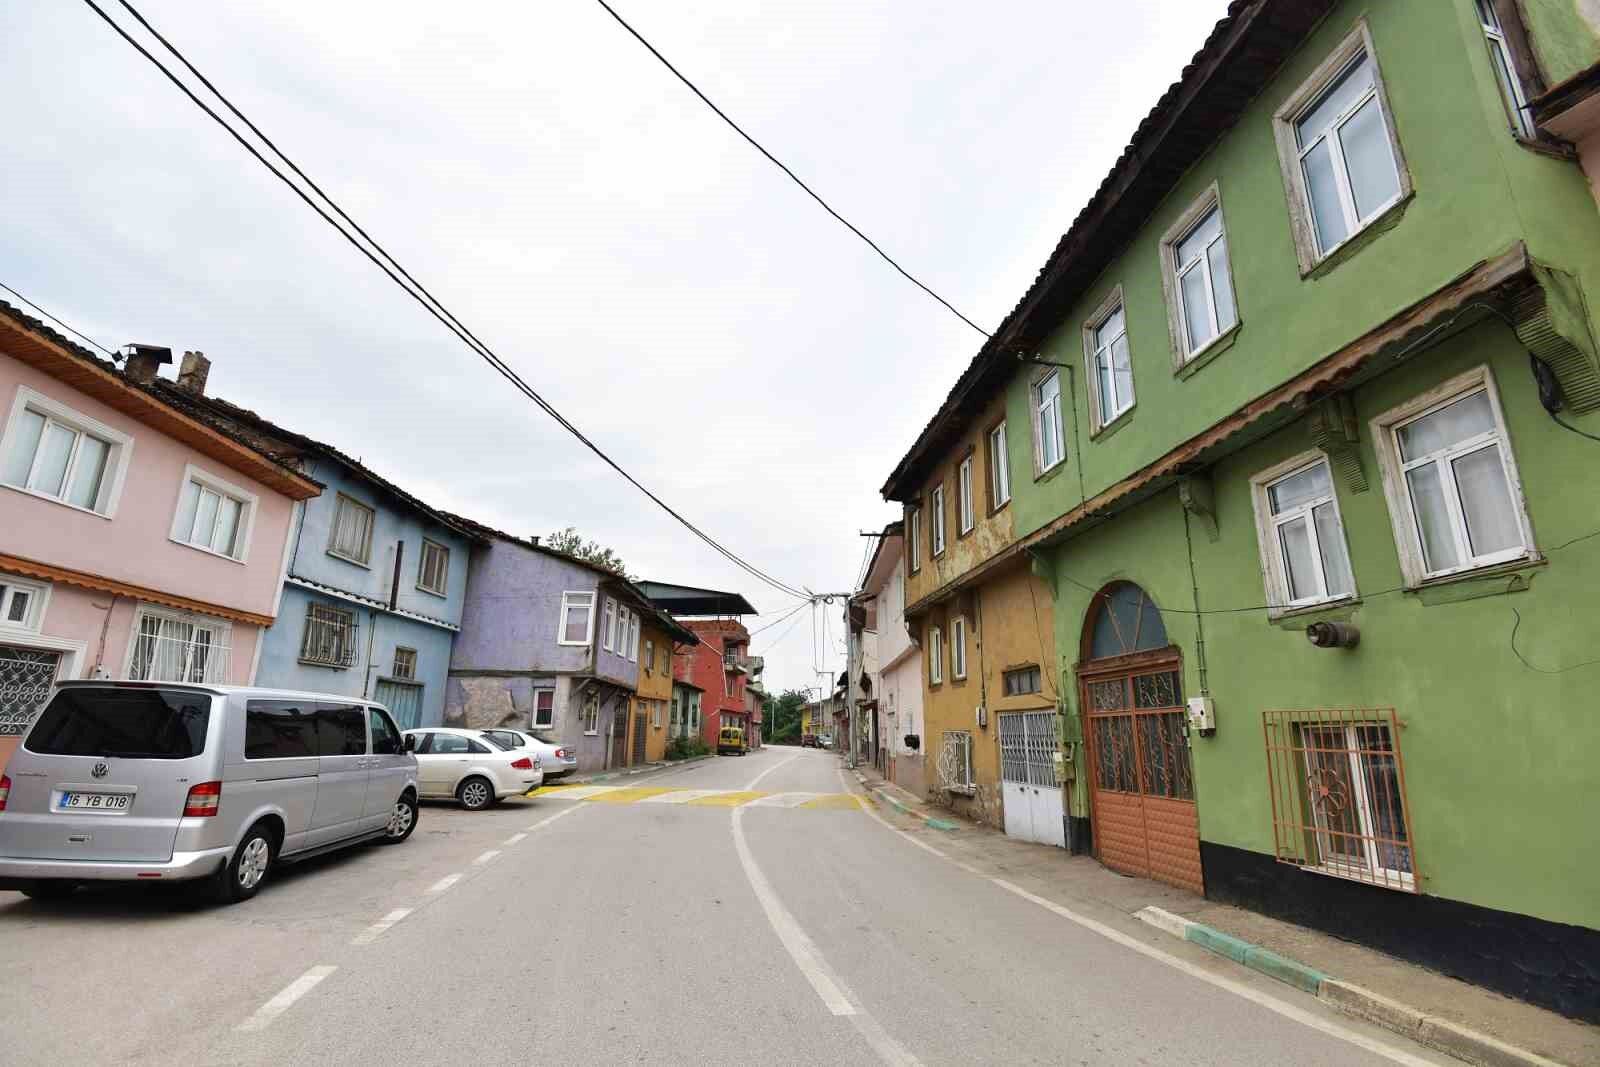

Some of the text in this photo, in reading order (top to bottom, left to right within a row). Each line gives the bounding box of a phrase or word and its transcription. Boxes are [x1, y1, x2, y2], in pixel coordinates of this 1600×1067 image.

[67, 794, 127, 808] 16 YB 018
